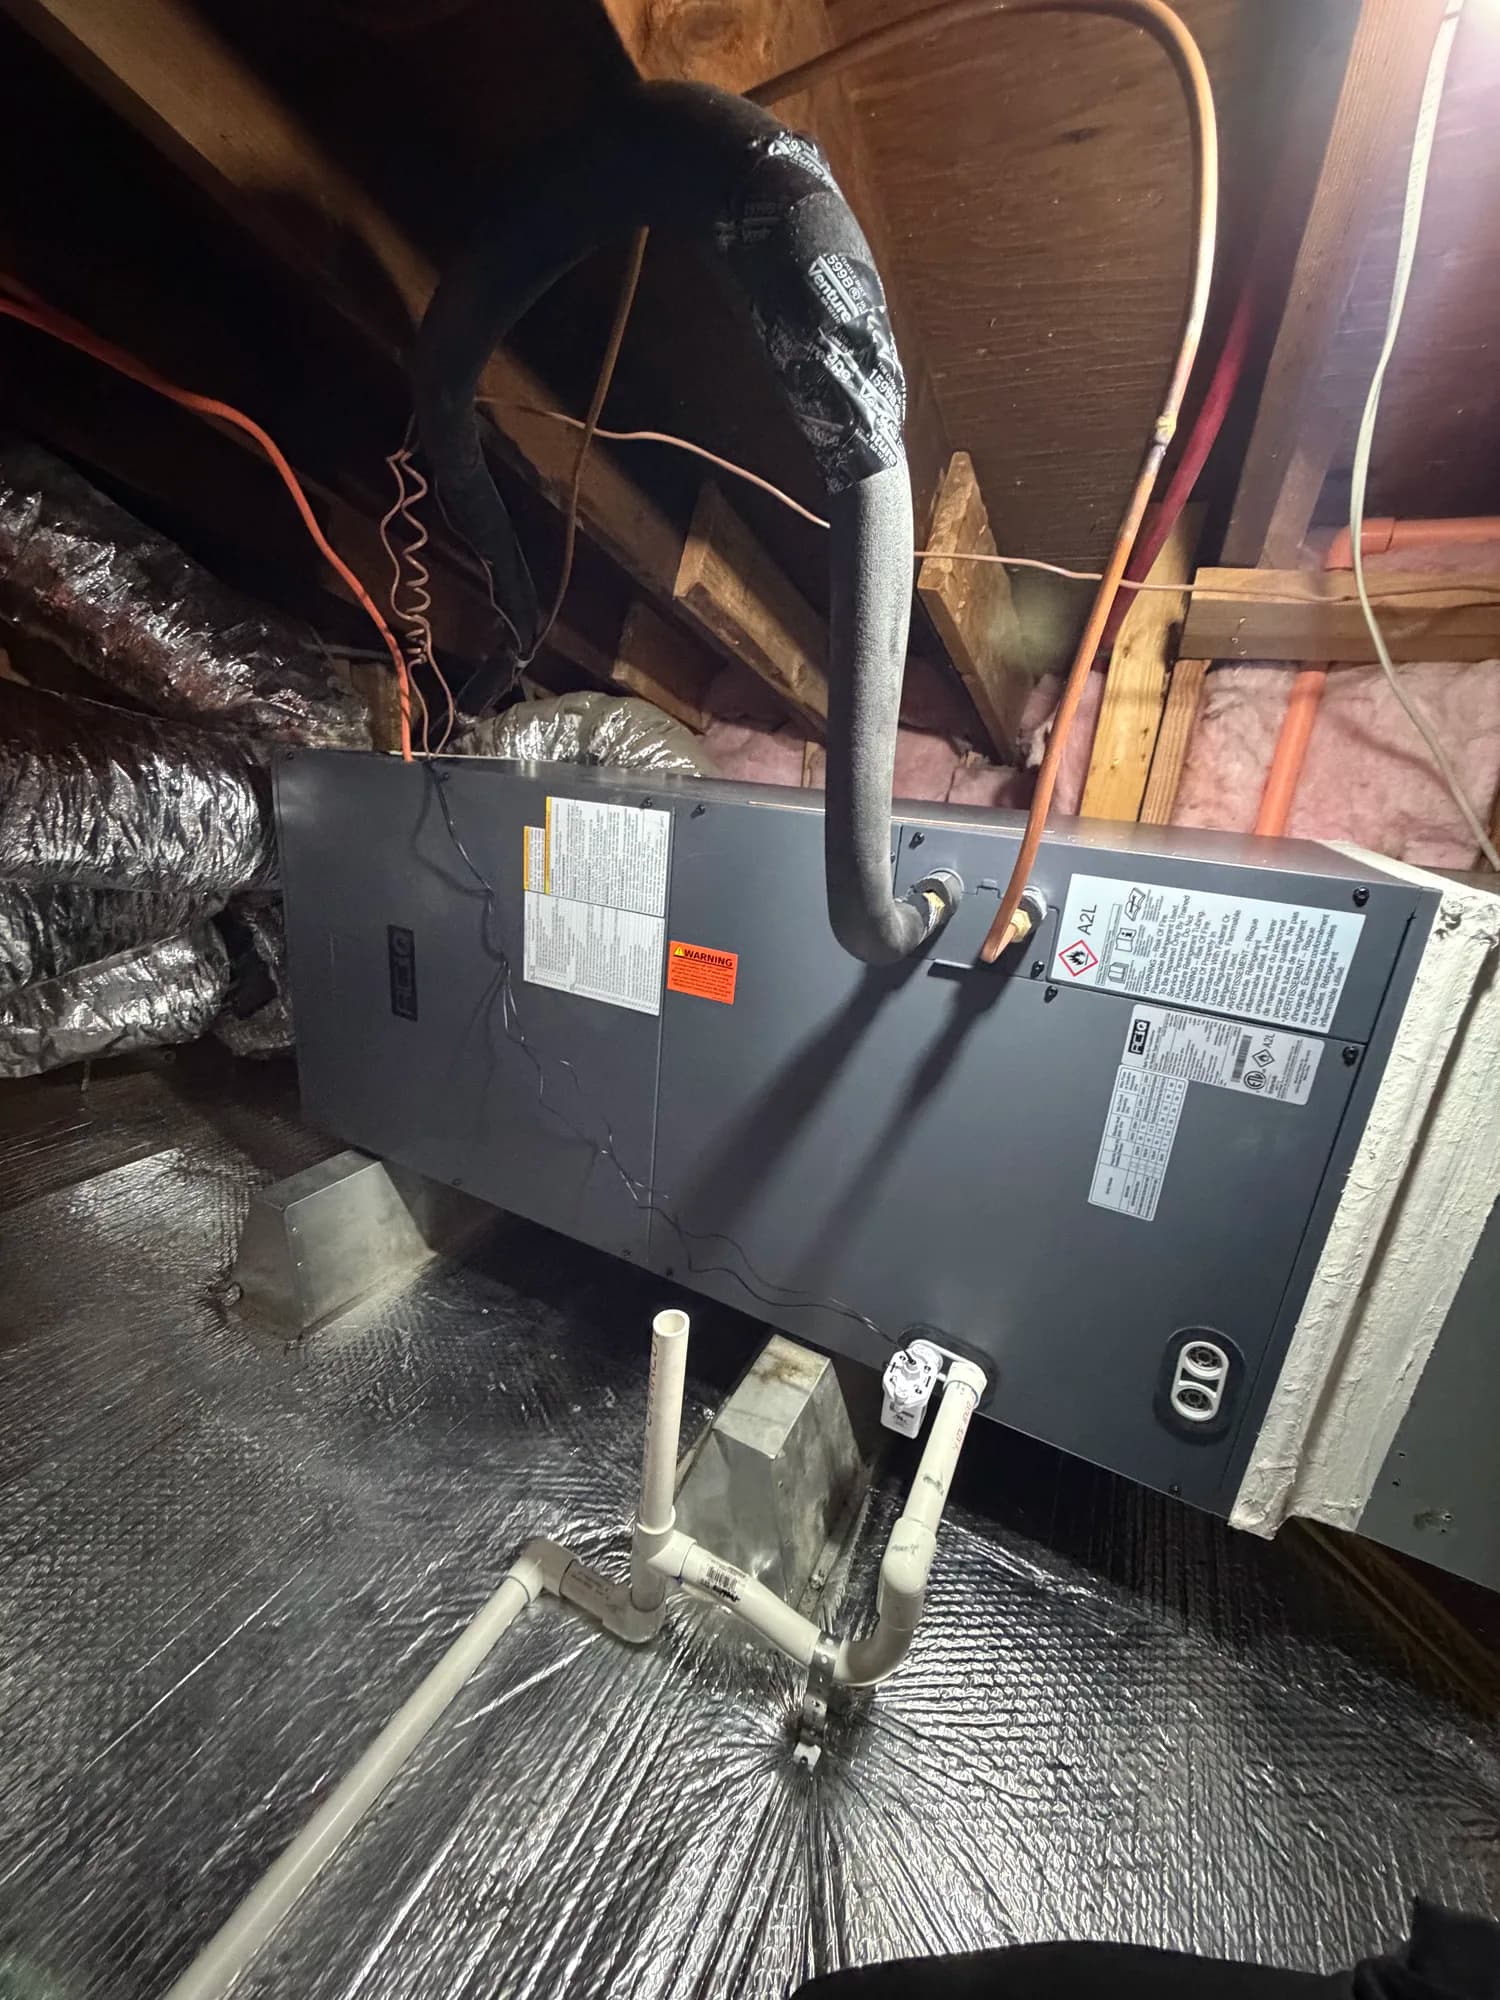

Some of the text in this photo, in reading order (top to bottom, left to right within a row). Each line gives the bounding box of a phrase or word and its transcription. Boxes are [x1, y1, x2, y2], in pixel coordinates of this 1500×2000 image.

[826, 254, 853, 288] 599B
[808, 261, 852, 323] Venture
[1077, 905, 1097, 936] A2L
[1185, 914, 1194, 927] Not
[1290, 911, 1300, 925] pas
[1156, 928, 1164, 937] Of
[1182, 928, 1191, 938] Do
[1198, 935, 1207, 944] Of
[1285, 926, 1295, 936] Ne
[1153, 938, 1162, 952] Risk
[1159, 895, 1190, 995] To Be Repaired Only By Trained
[1194, 946, 1204, 960] Risk
[1201, 939, 1216, 966] Properly
[684, 948, 733, 967] WARNING
[1151, 960, 1165, 994] Flammable
[1160, 924, 1174, 959] Refrigerant
[1175, 971, 1189, 999] Puncture
[1183, 935, 1198, 970] Refrigerant
[1201, 914, 1230, 1004] Accordance With Federal Or
[1209, 988, 1219, 1006] Local
[1225, 910, 1241, 946] Flammable
[1227, 950, 1249, 1009] AVERTISSEMENT
[1245, 918, 1259, 942] Risque
[1254, 920, 1287, 1014] uniquement par du personnel
[1288, 956, 1297, 965] de
[1143, 959, 1157, 992] WARNING
[1199, 966, 1207, 976] Of
[1282, 959, 1305, 1020] AVERTISSEMENT
[1302, 927, 1316, 951] Risque
[1282, 966, 1293, 985] tubes
[1167, 974, 1179, 997] Service
[1184, 967, 1198, 1000] WARNING
[1192, 976, 1205, 1002] Dispose
[1218, 972, 1233, 1007] Refrigerant
[1245, 974, 1261, 1013] inflammable
[1266, 965, 1283, 1006] maintenance
[1278, 986, 1287, 996] les
[1263, 1007, 1271, 1016] de
[1272, 997, 1284, 1019] percer
[1300, 1012, 1310, 1024] aux
[1319, 988, 1338, 1028] inflammable
[1310, 1016, 1318, 1026] ou
[1263, 1033, 1276, 1049] A2L
